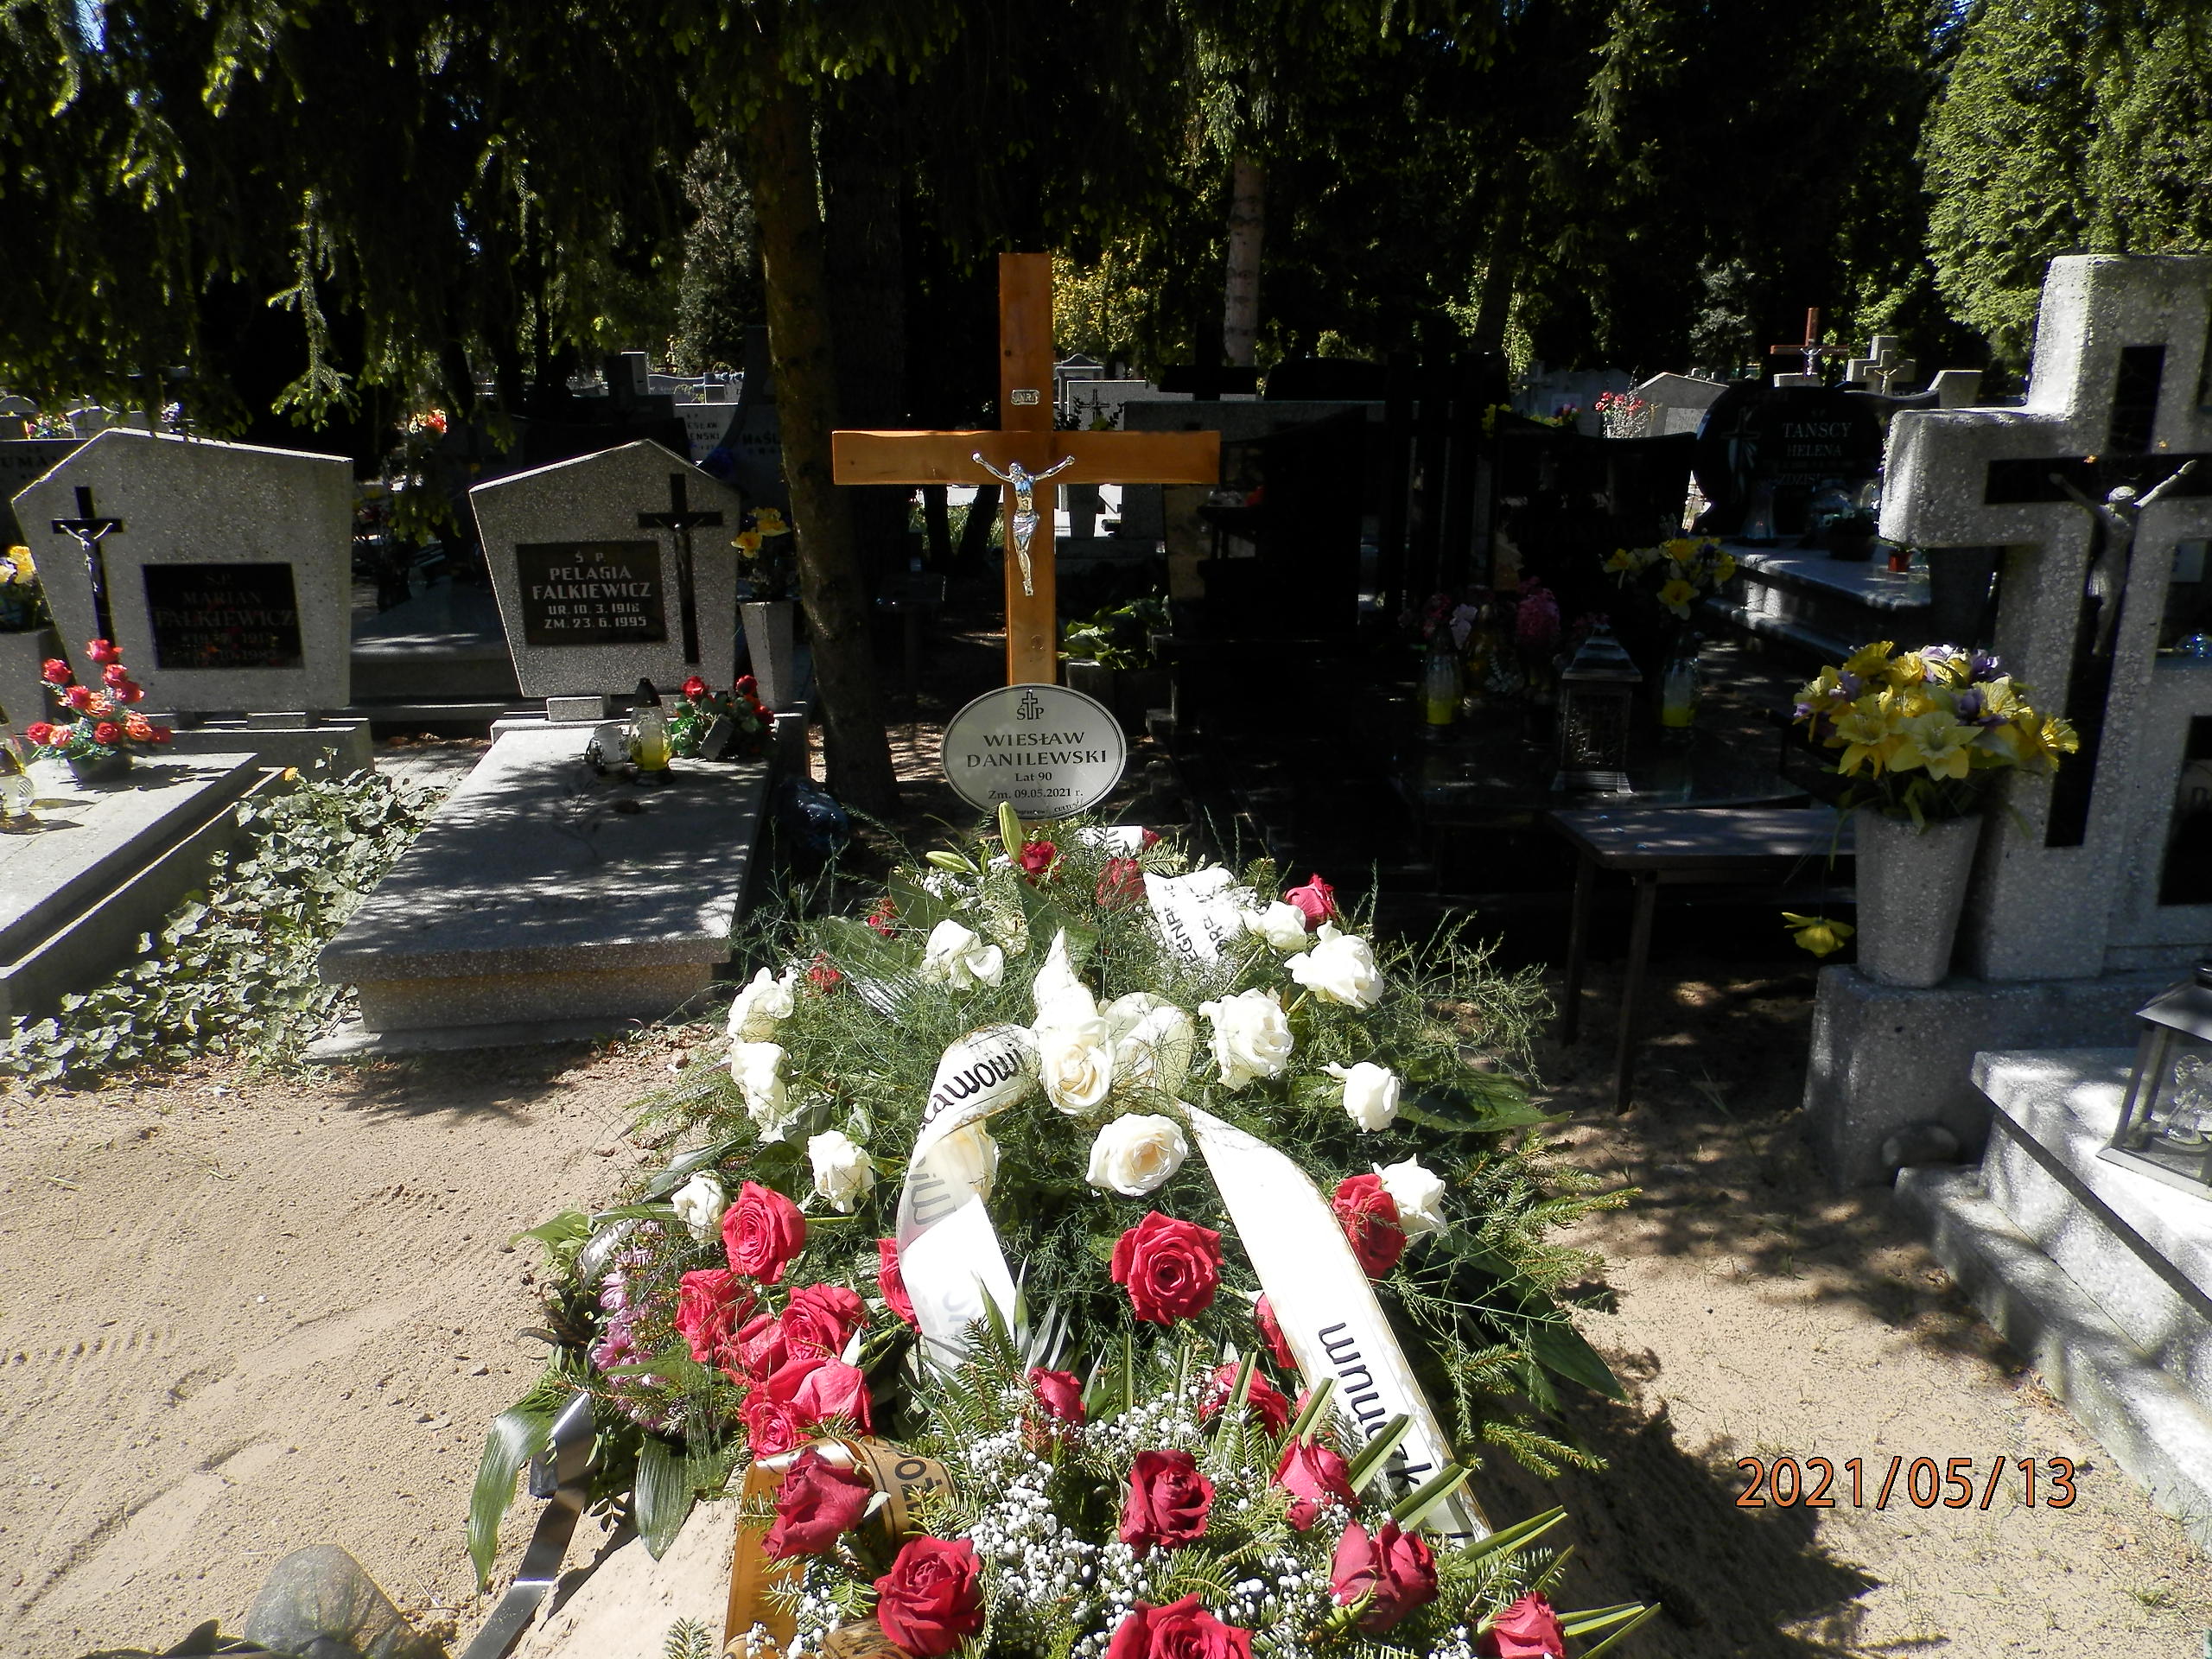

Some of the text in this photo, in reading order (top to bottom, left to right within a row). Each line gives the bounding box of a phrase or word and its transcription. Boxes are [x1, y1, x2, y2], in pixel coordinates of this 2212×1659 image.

[1783, 422, 1853, 438] TANSCY
[1786, 443, 1842, 457] HELENA
[549, 565, 632, 581] PELAGIA
[182, 591, 264, 604] MARIAN
[531, 582, 652, 601] FALKIEWICZ
[982, 731, 1085, 747] WIESŁAW
[966, 749, 1107, 768] DANILEWSKI
[1014, 772, 1052, 782] Lat 90
[988, 790, 1011, 799] Zm.
[1014, 787, 1071, 798] 09.05.2021
